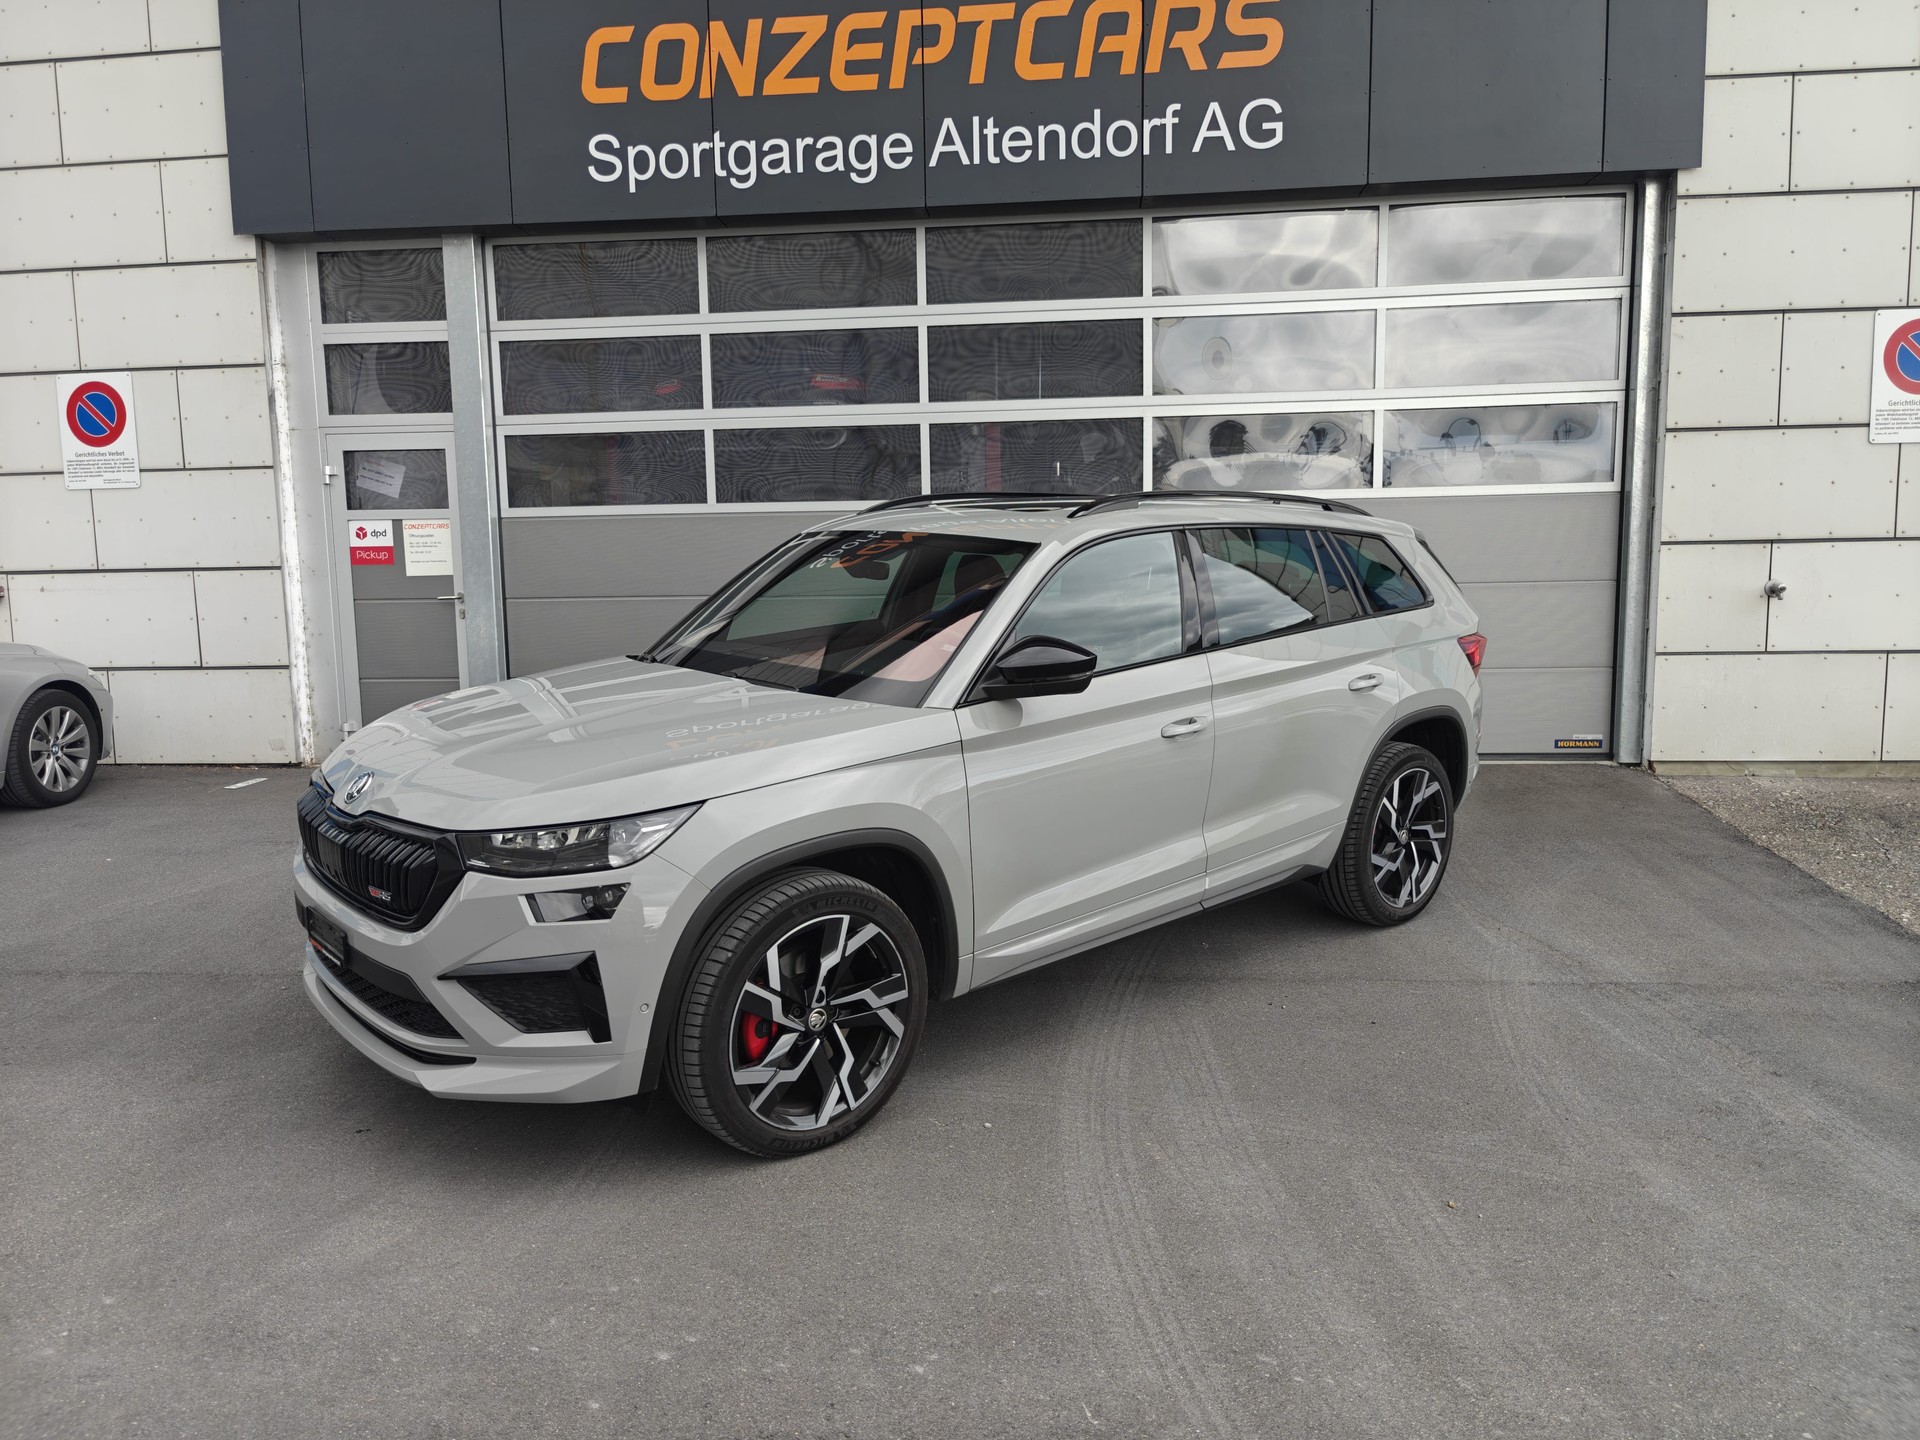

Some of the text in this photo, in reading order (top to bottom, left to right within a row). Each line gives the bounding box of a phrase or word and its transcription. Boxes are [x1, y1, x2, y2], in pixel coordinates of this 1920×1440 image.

[580, 0, 1285, 104] CONZEPTCARS
[587, 97, 1285, 194] Sportgarage Altendorf AG
[356, 550, 389, 561] Pickup
[370, 529, 387, 539] dpd
